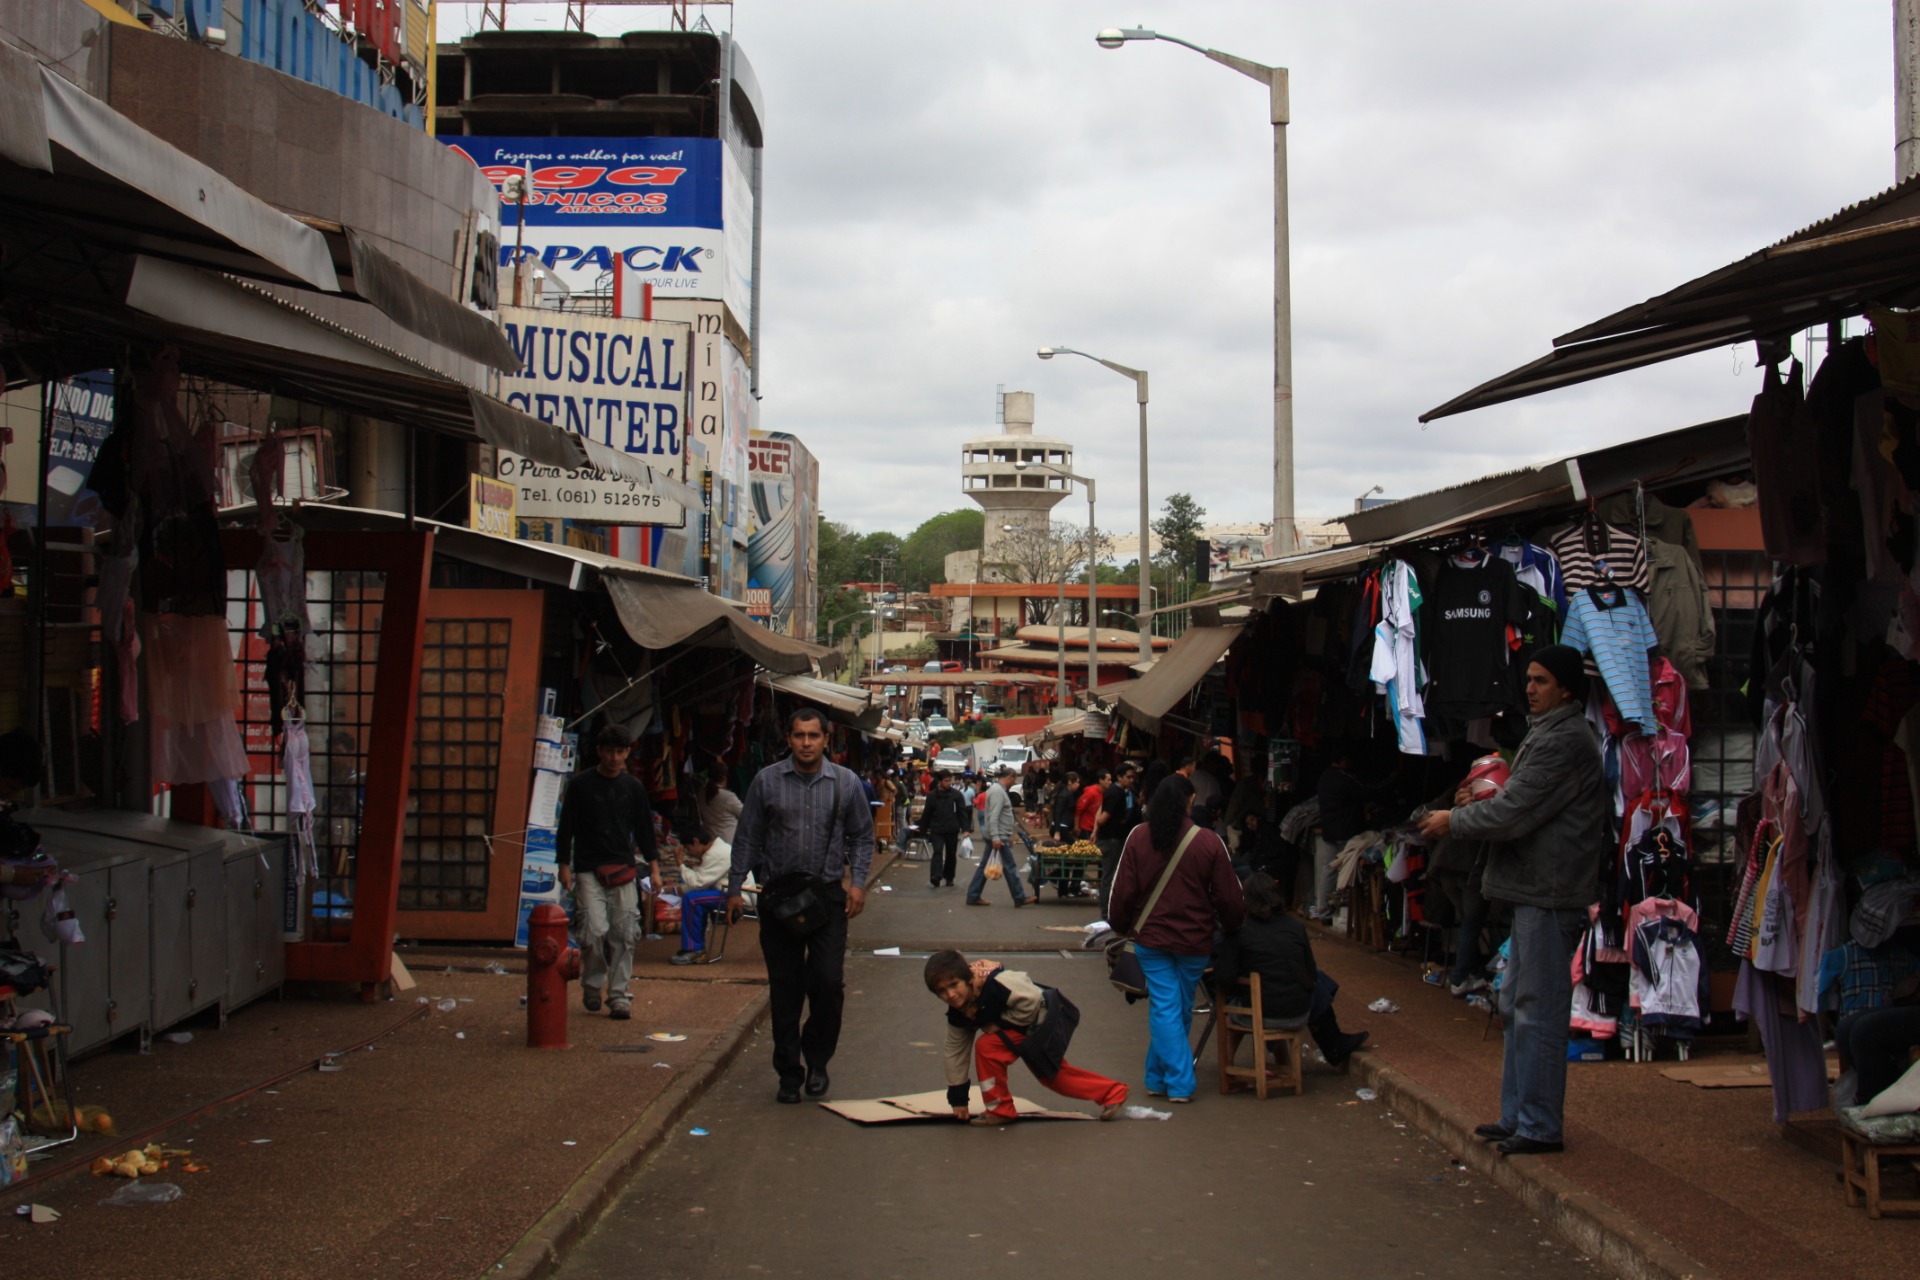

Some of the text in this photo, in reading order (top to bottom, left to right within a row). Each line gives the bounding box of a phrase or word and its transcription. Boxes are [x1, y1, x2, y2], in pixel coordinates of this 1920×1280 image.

[494, 148, 684, 164] Fazemos o melhor por você!
[555, 205, 668, 214] ATACADO
[643, 277, 698, 289] YOUR LIVE
[504, 323, 683, 391] MUSICAL
[499, 457, 515, 476] O
[519, 458, 561, 478] Puro
[521, 488, 552, 502] Tel.
[556, 487, 597, 504] (061)
[603, 492, 661, 508] 512675
[478, 507, 510, 536] SONY
[1444, 607, 1492, 620] SAMSUNG
